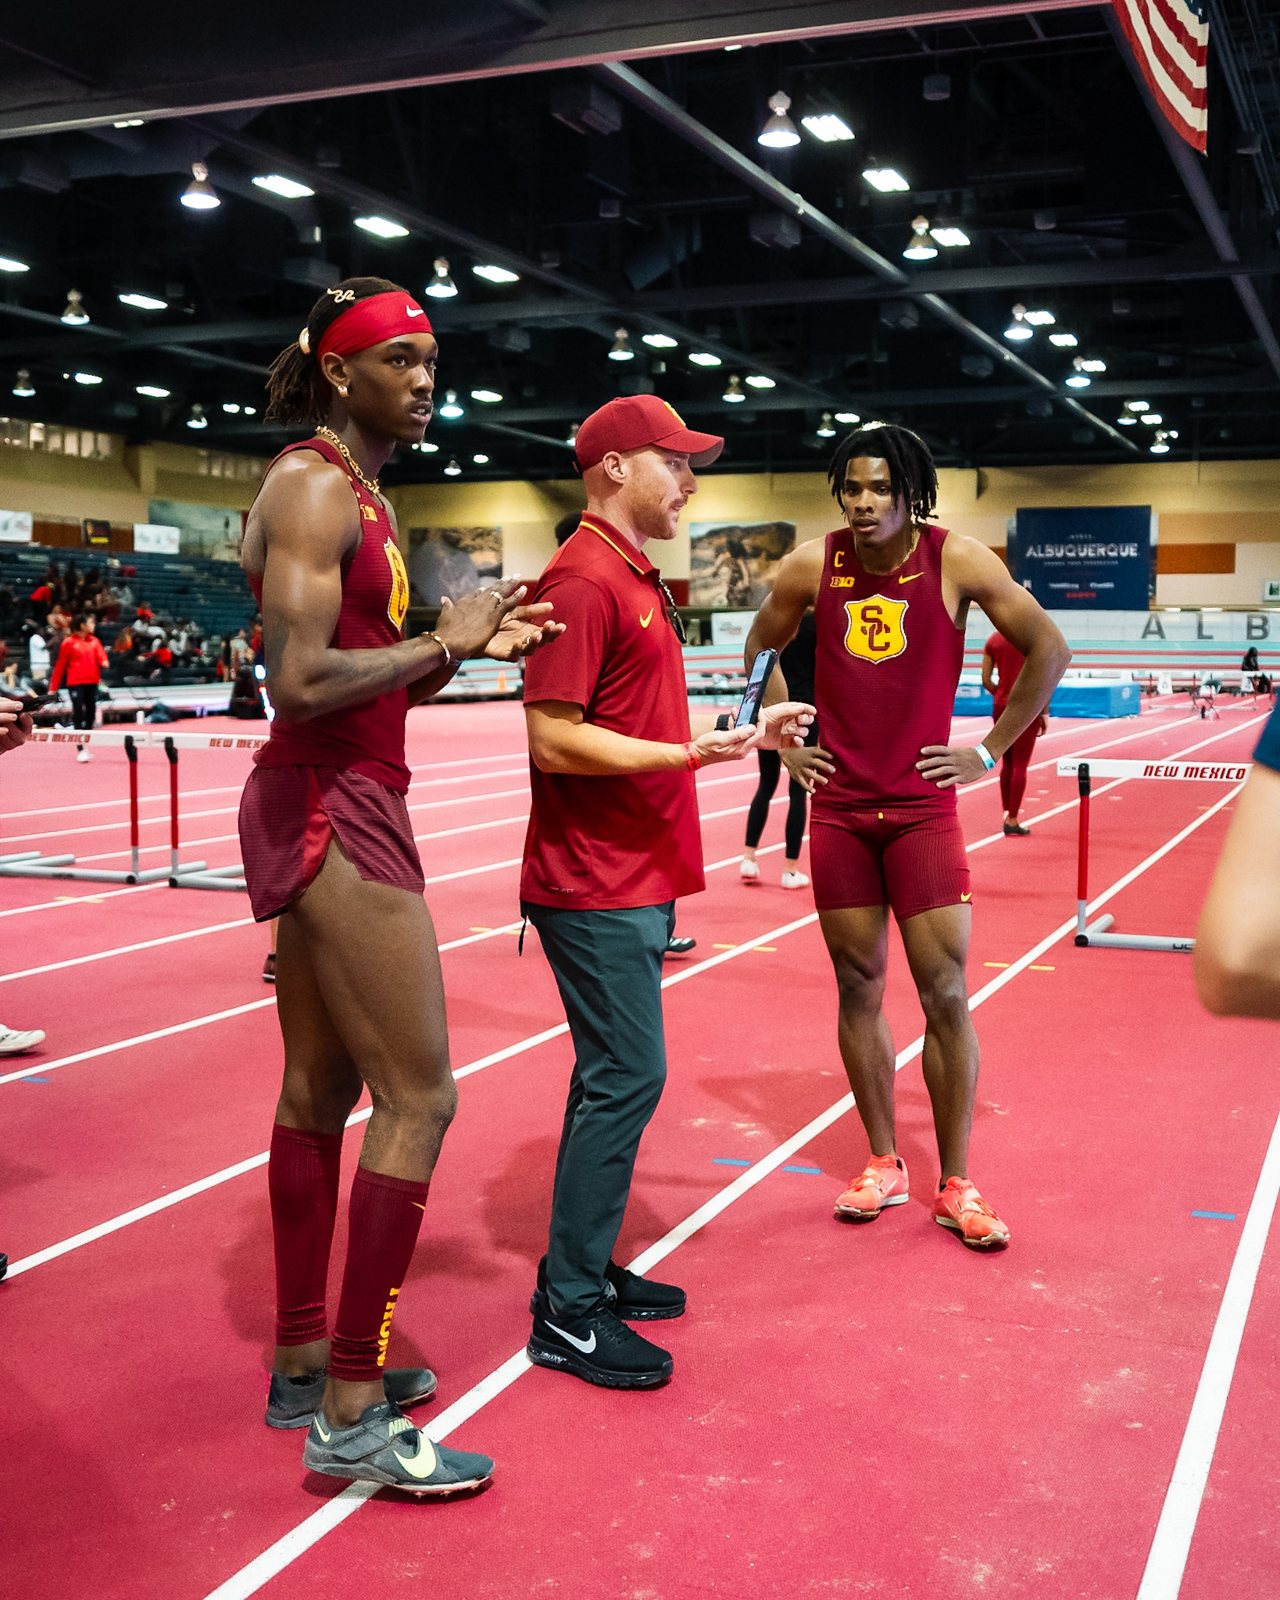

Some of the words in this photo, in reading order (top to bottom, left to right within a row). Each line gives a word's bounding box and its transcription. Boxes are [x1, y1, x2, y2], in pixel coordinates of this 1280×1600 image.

[1025, 543, 1138, 558] ALBUQUERQUE
[834, 551, 845, 567] C
[209, 738, 233, 747] NEW
[1143, 765, 1179, 777] NEW
[1183, 766, 1247, 780] MEXICO
